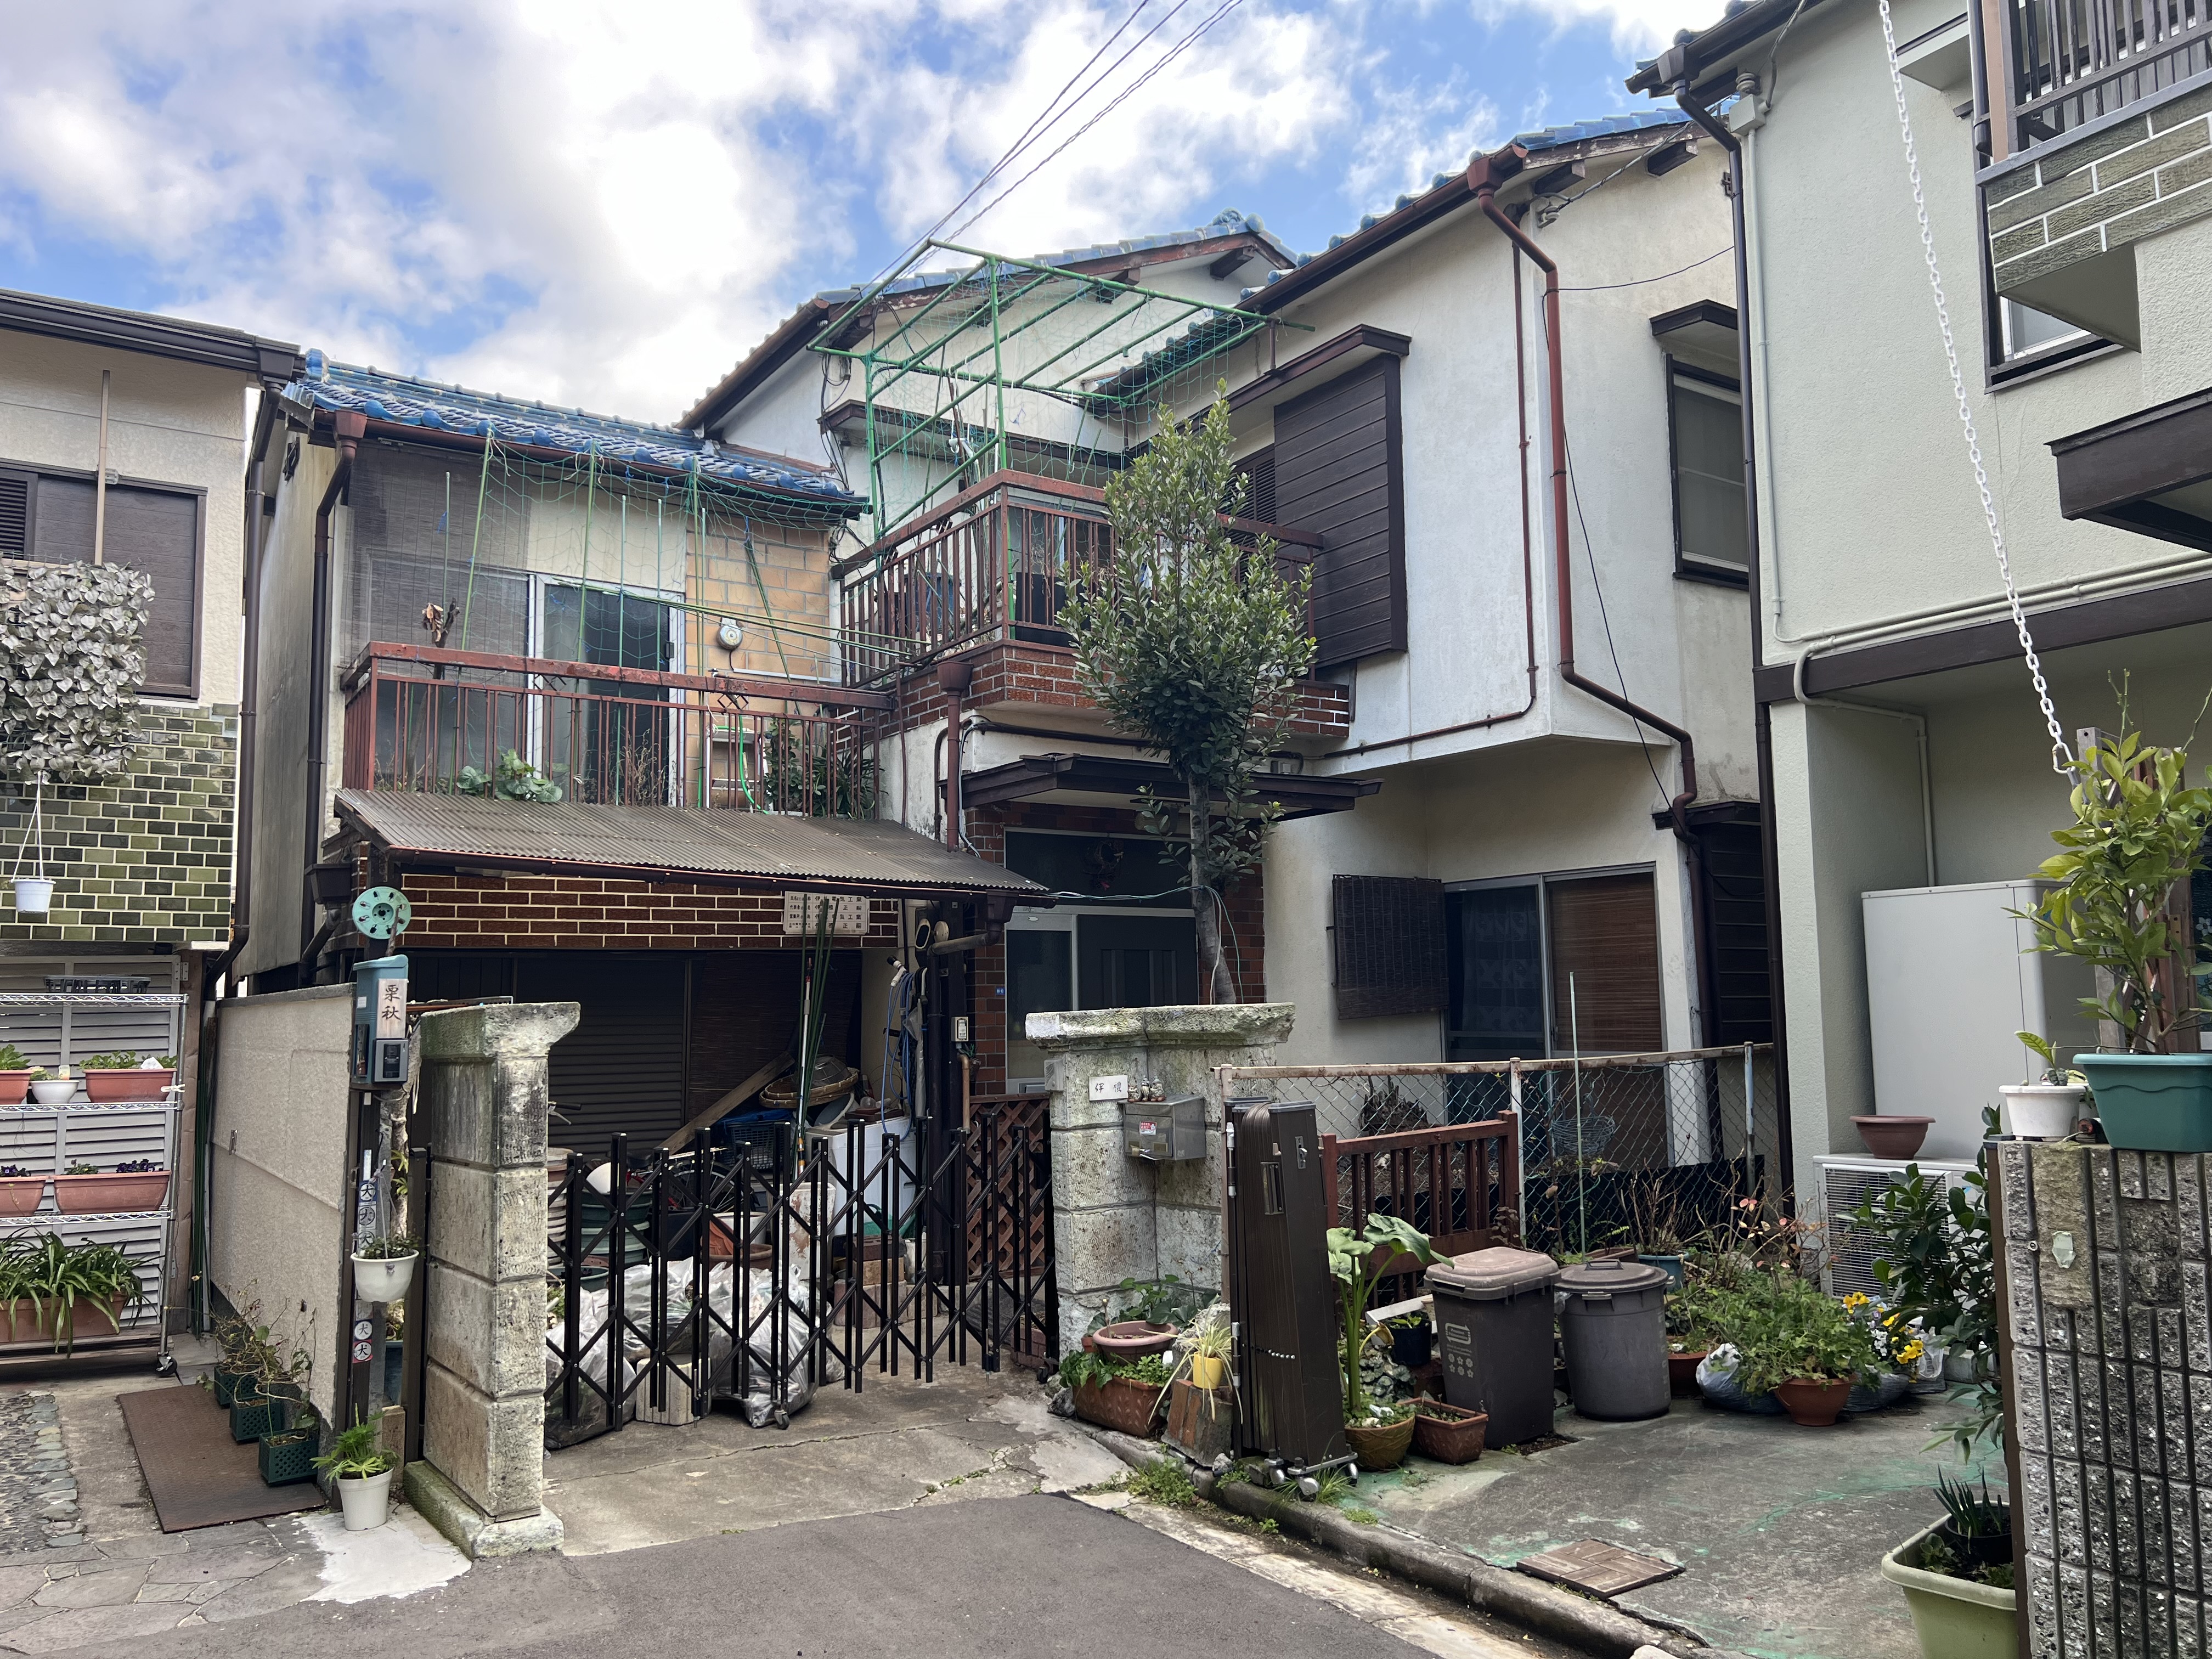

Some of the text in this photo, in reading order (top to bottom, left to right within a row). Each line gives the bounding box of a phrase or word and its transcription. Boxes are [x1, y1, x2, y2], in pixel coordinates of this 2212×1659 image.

[382, 984, 401, 1020] 栗秋
[360, 1184, 374, 1197] 犬
[358, 1323, 369, 1335] 犬
[357, 1344, 369, 1357] 犬
